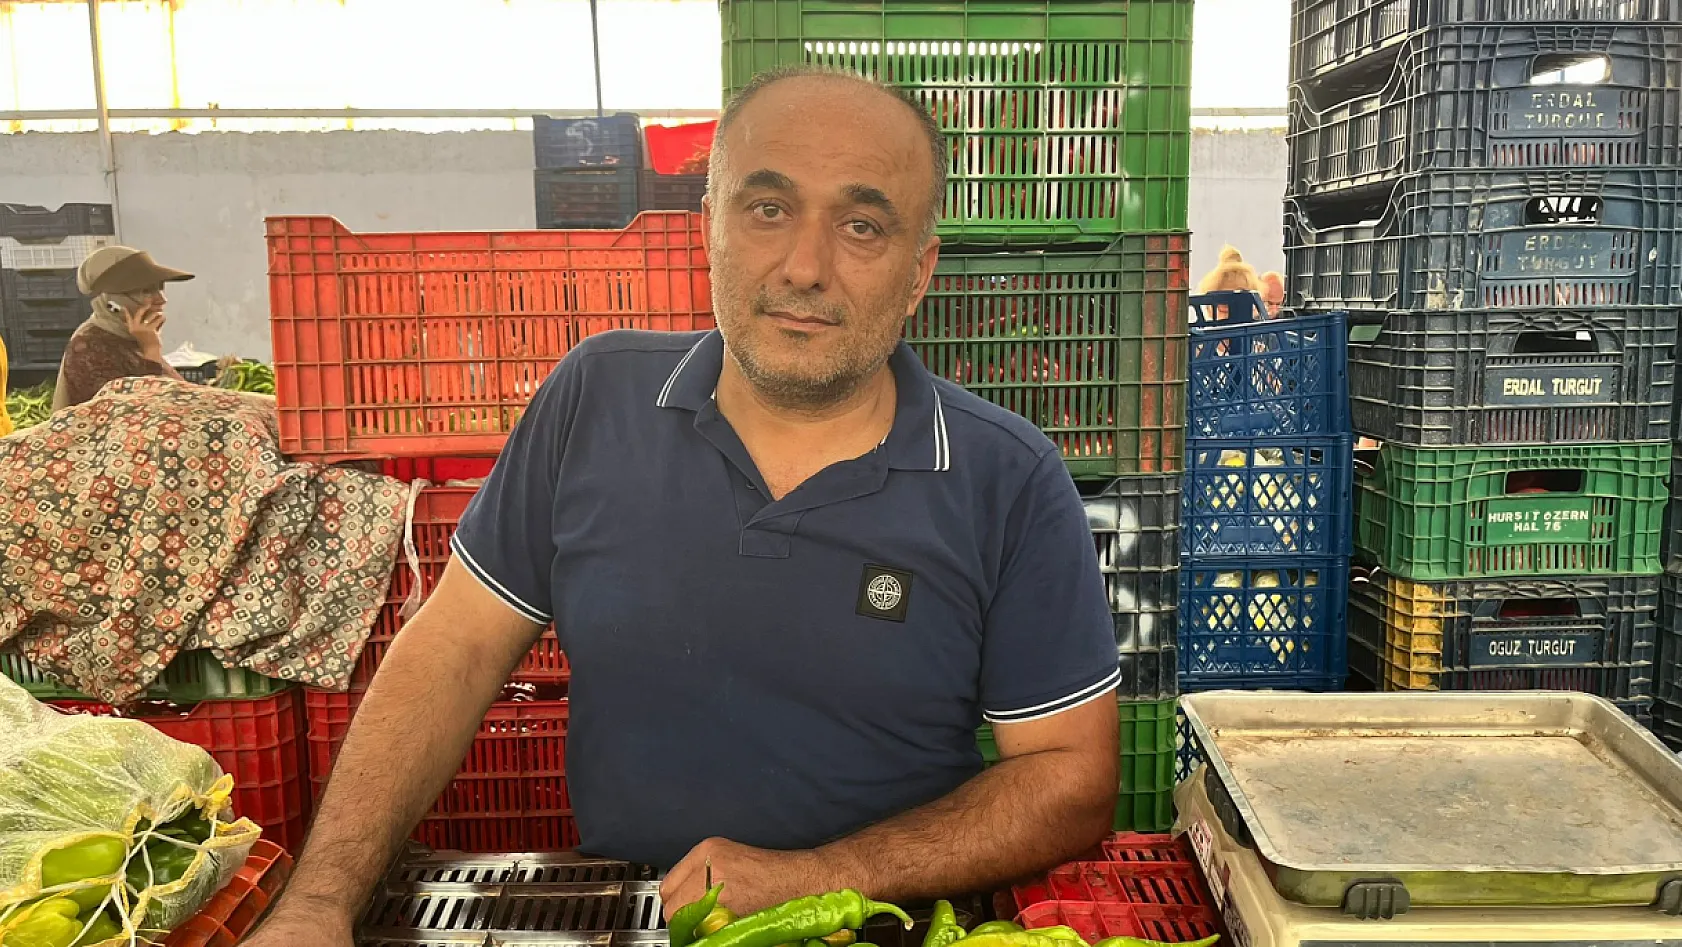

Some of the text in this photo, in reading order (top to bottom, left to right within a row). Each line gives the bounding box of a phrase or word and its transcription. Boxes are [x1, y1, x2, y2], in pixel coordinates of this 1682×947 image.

[1531, 92, 1597, 108] ERDAL
[1503, 378, 1603, 396] ERDAL TURGUT
[1513, 521, 1562, 532] HAL 76
[1489, 639, 1577, 656] OGUZ TURGUT
